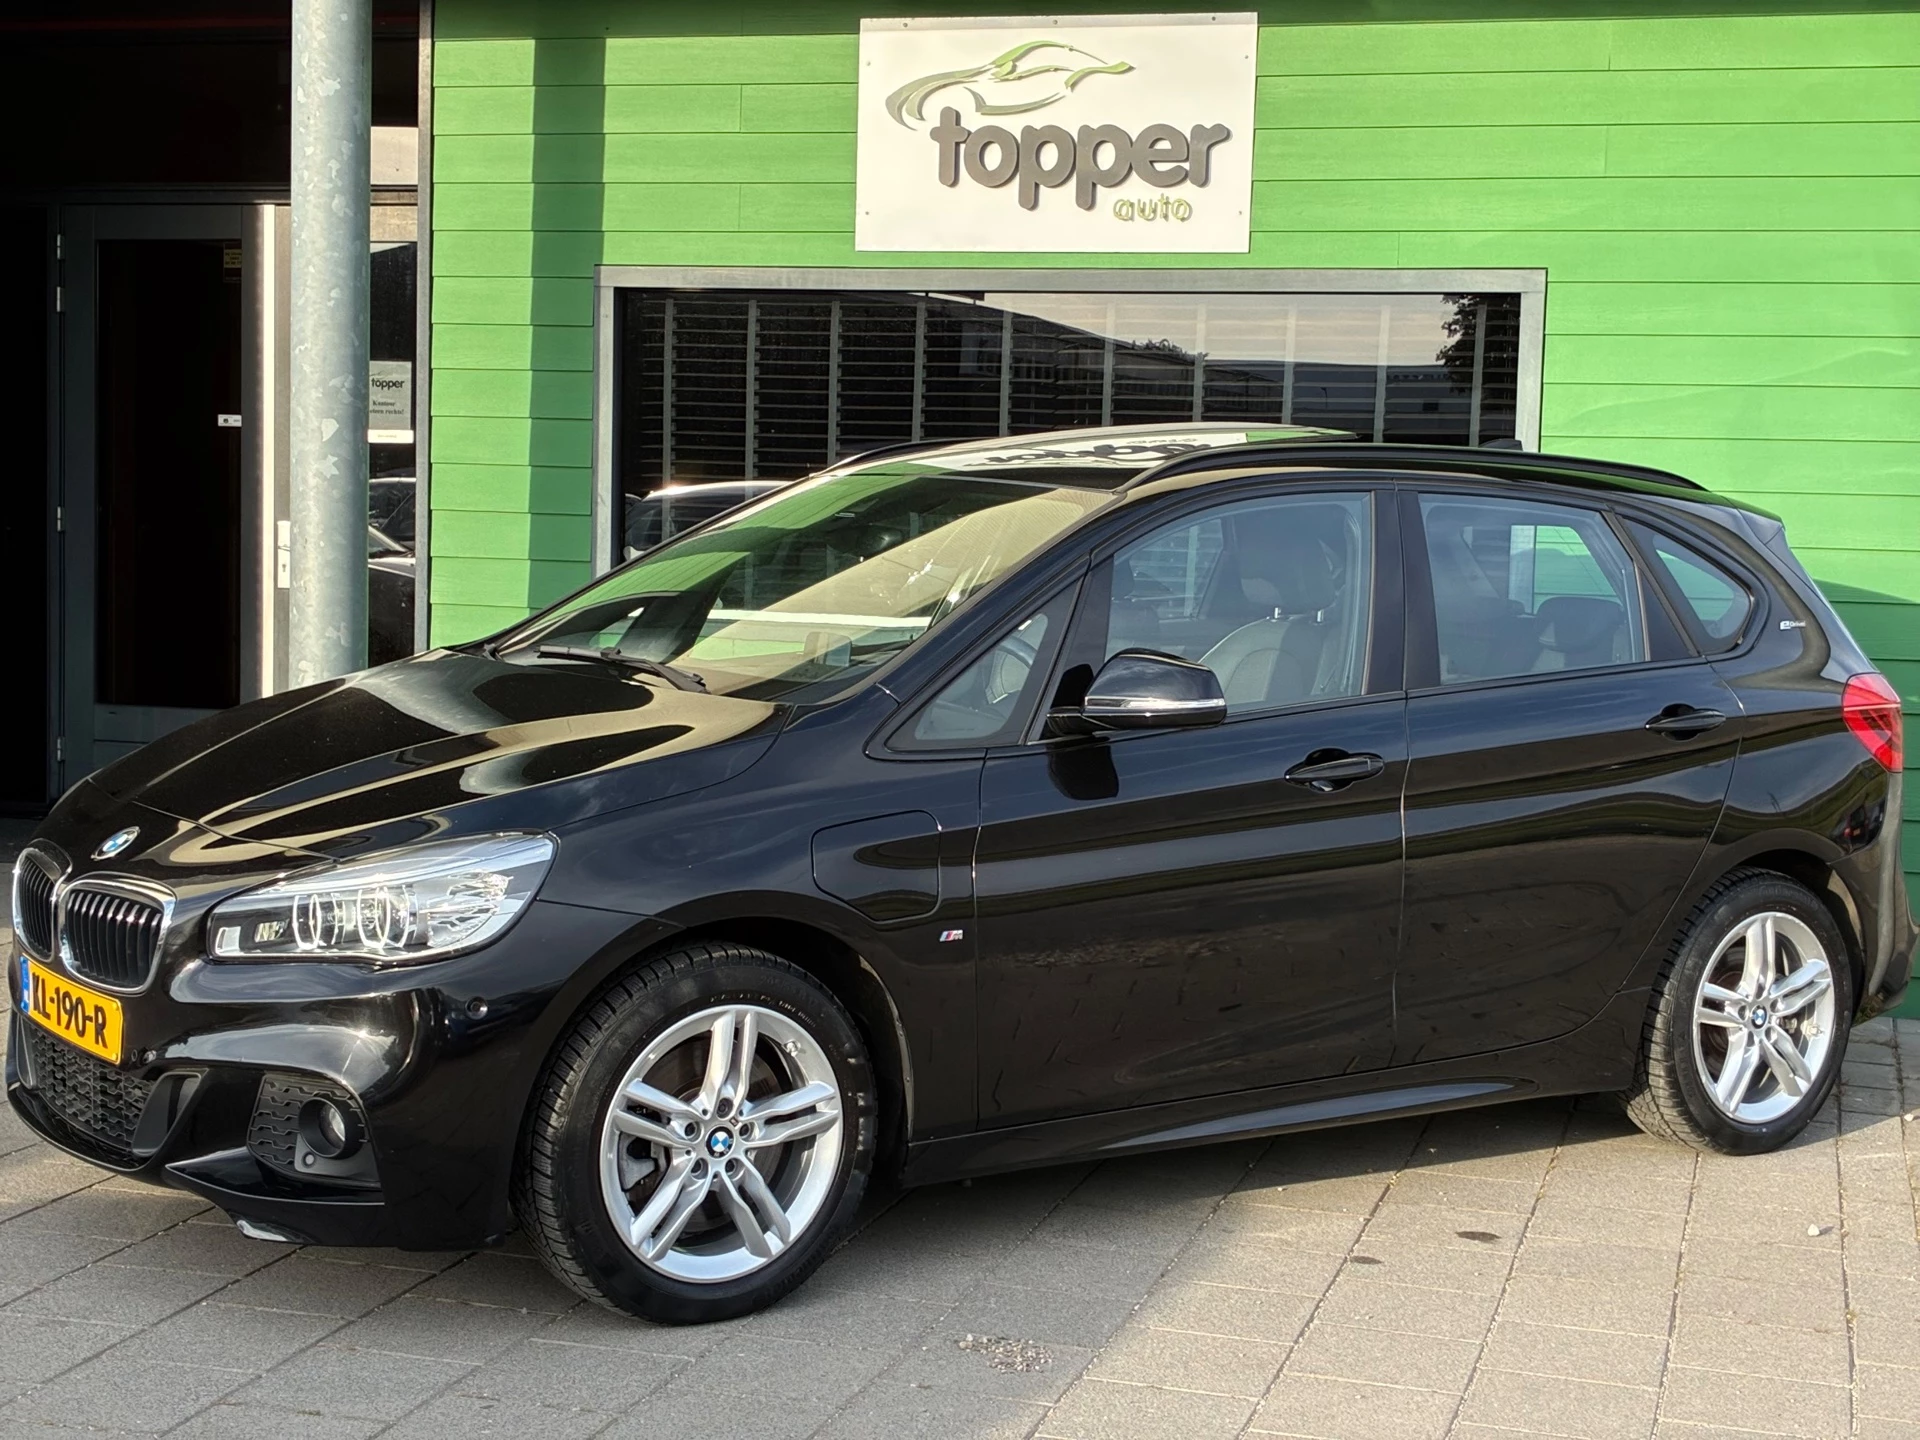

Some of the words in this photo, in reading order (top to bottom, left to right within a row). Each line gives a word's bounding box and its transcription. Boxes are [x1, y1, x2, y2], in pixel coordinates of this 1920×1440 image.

[930, 106, 1232, 210] topper
[1113, 193, 1193, 221] auto
[371, 377, 405, 390] topper
[31, 971, 108, 1049] KL-190-R
